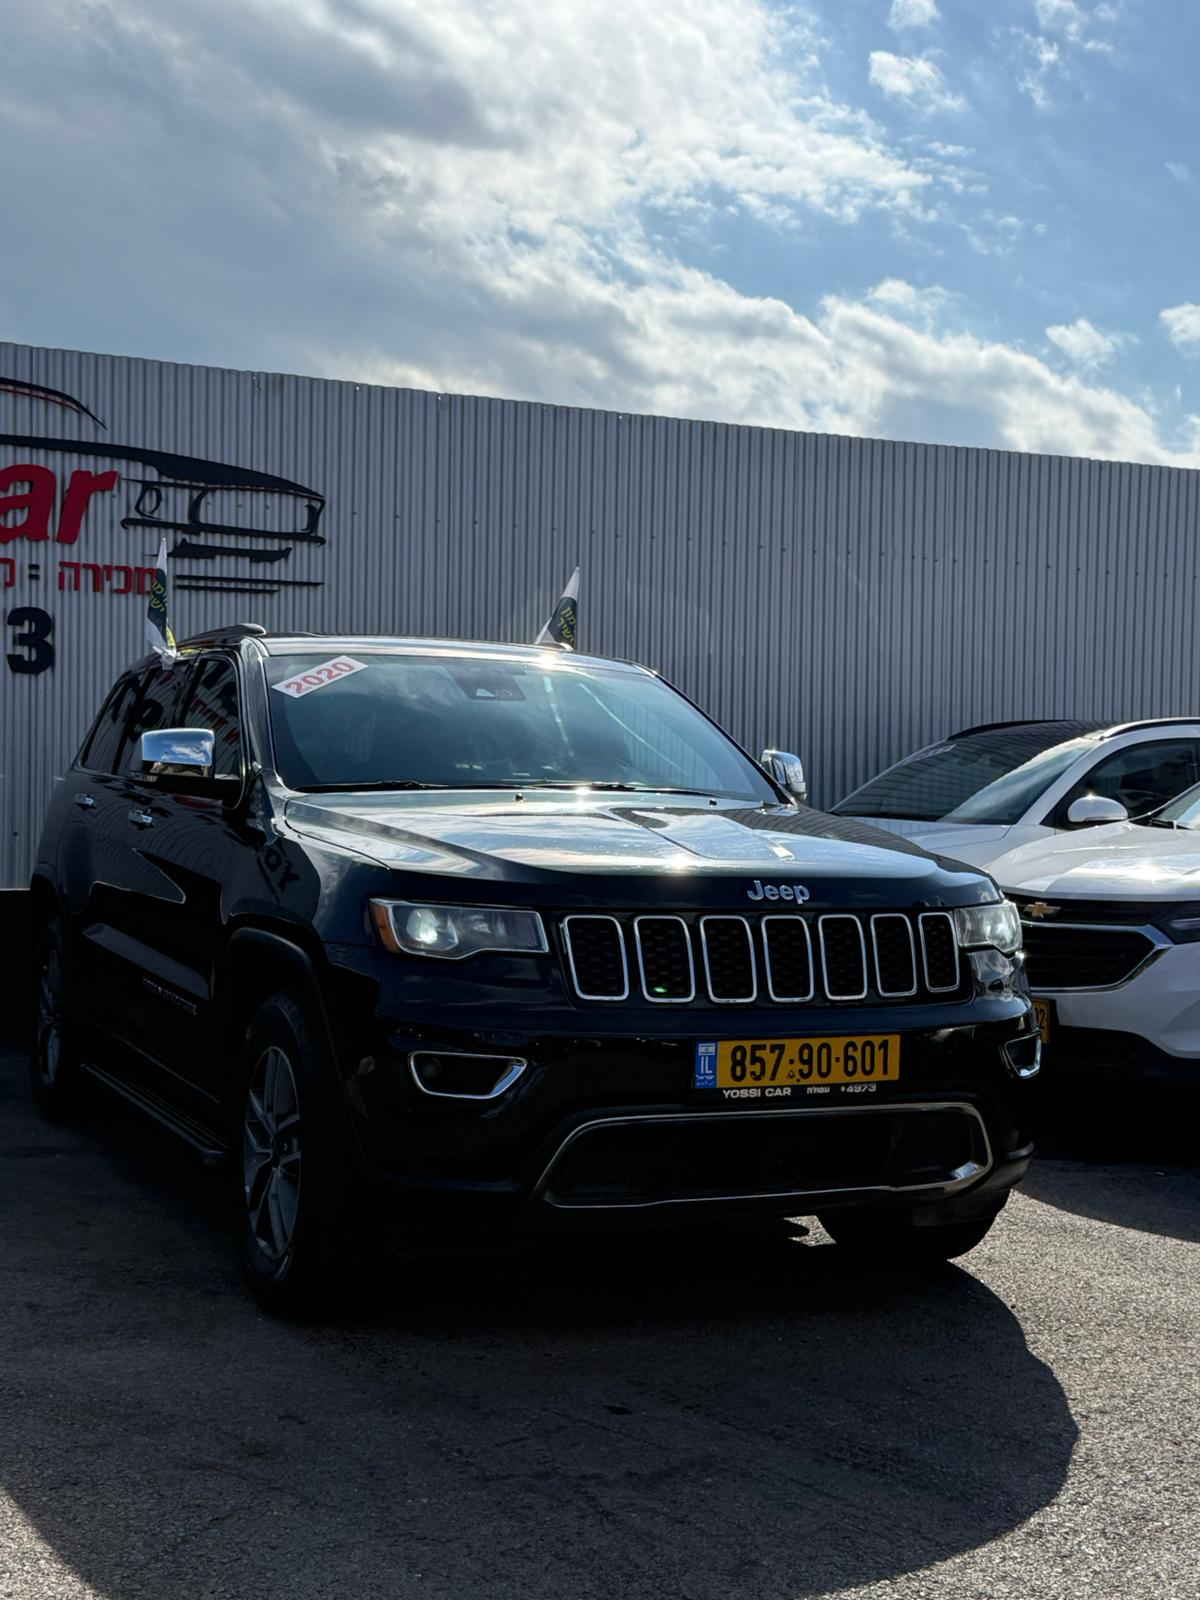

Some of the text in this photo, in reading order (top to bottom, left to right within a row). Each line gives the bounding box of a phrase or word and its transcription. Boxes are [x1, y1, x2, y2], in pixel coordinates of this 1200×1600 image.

[58, 561, 157, 595] מכירה
[6, 606, 55, 675] 3
[285, 662, 354, 694] 2020
[746, 880, 810, 905] Jeep
[700, 1056, 713, 1074] IL
[722, 1089, 761, 1099] YOSSI
[765, 1087, 792, 1097] CAR
